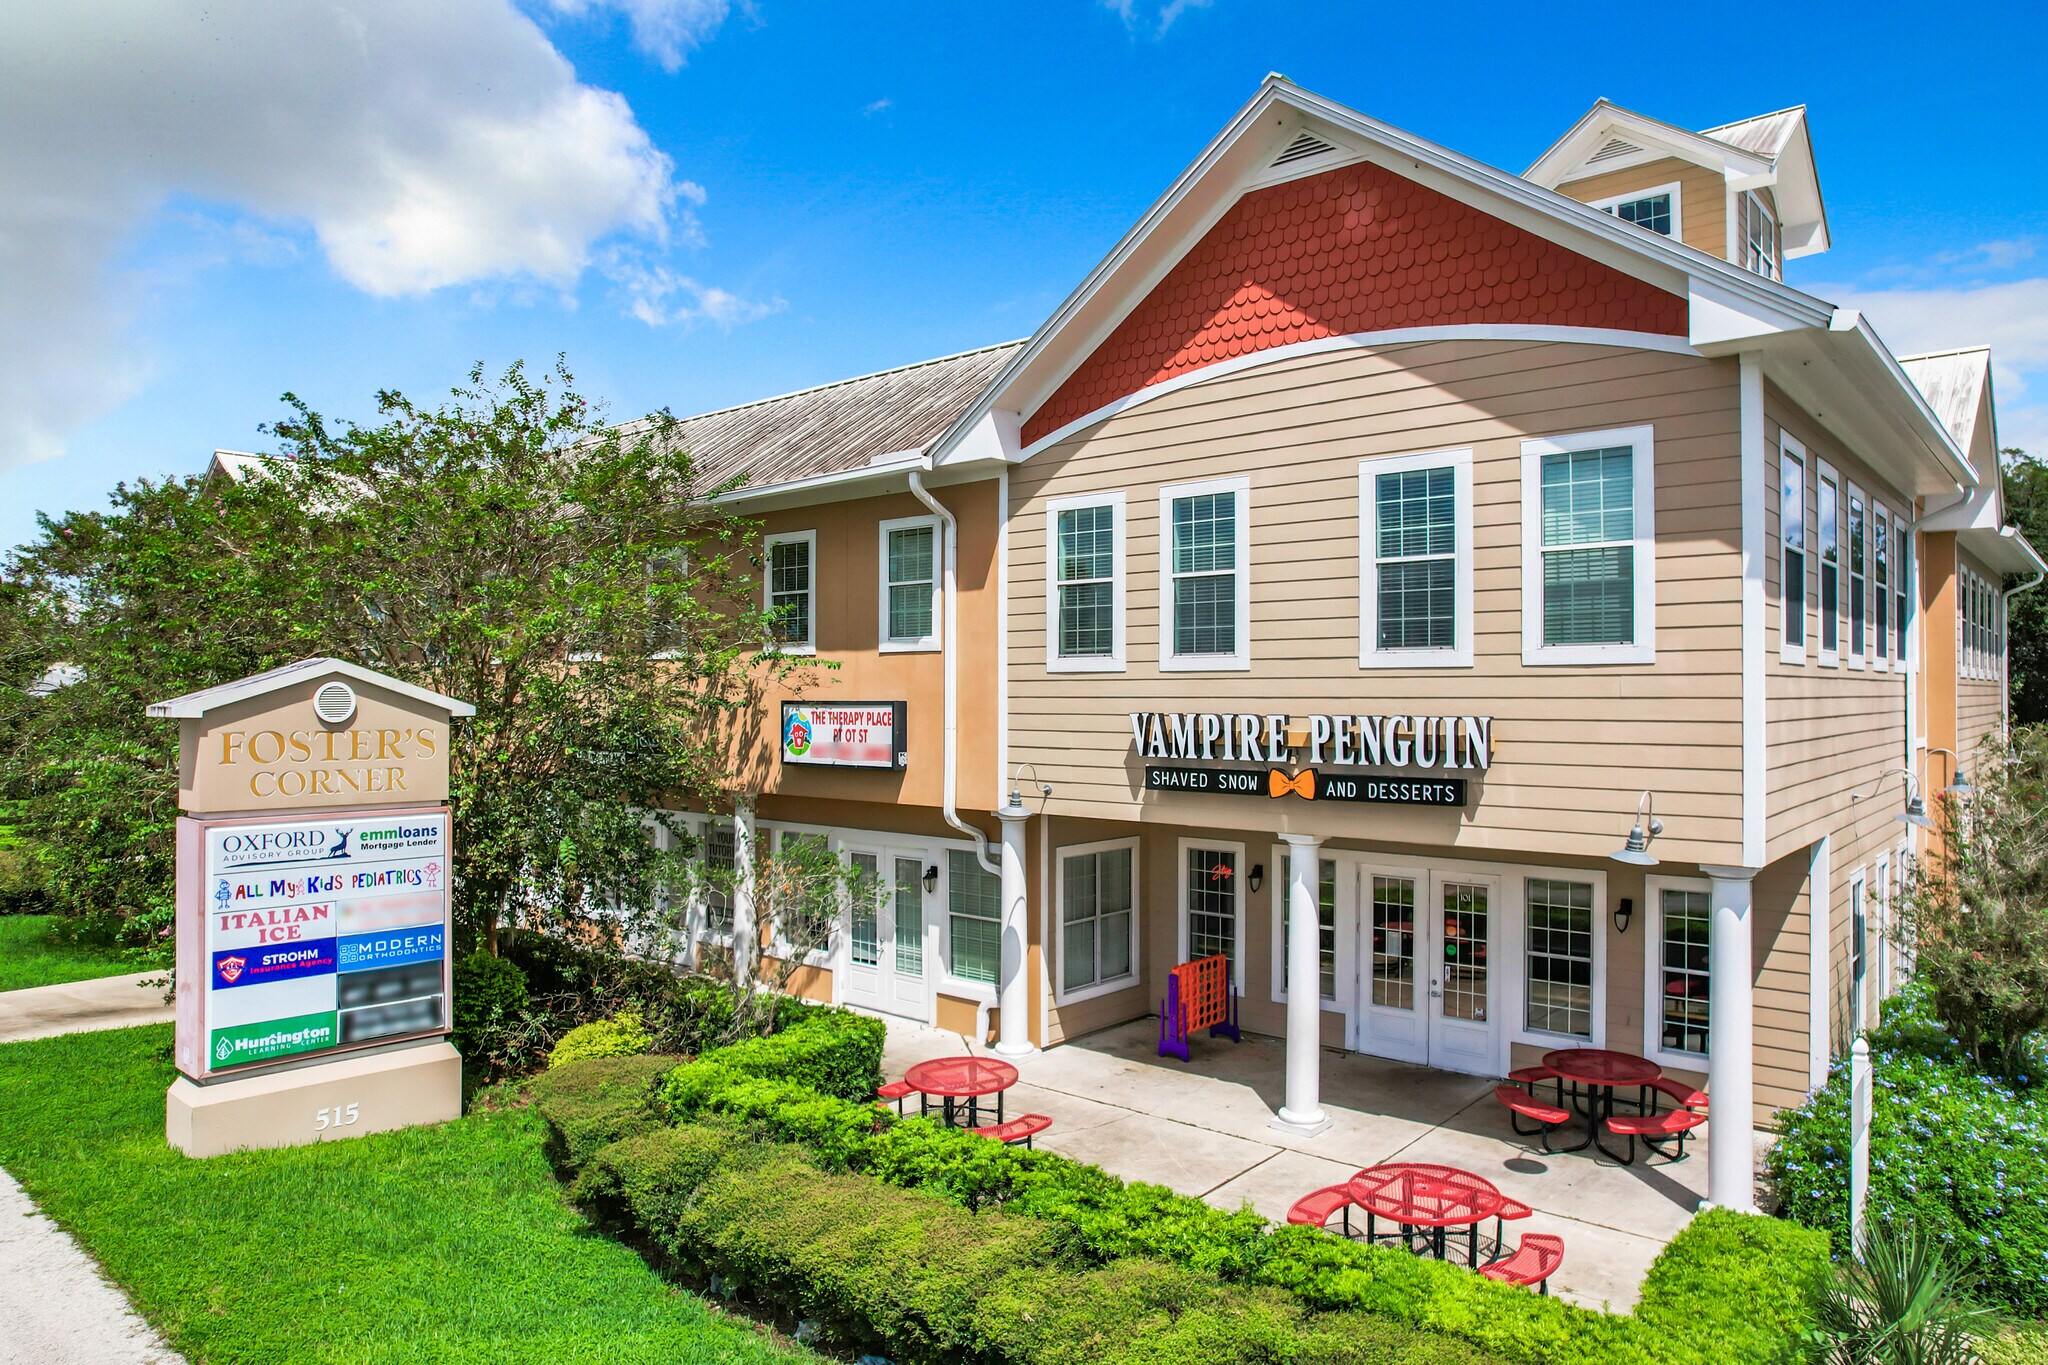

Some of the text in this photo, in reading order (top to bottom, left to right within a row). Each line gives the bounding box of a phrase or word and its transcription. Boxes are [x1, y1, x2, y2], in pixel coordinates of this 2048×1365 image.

[811, 711, 892, 726] THE THERAPY PLACE
[845, 729, 857, 743] OT
[858, 729, 868, 743] ST
[1129, 712, 1492, 769] VAMPIRE PENGUIN
[218, 728, 437, 766] FOSTER'S
[250, 767, 408, 798] CORNER
[1152, 771, 1455, 802] SHAVED SNOW AND DESSERTS
[223, 830, 325, 853] OXFORD
[360, 826, 438, 841] emmloans
[223, 848, 325, 862] ADVISORY GROUP
[361, 839, 437, 851] Mortgage Lender
[235, 884, 264, 900] ALL
[270, 879, 296, 899] My
[352, 869, 422, 889] PEDIATRICS
[220, 904, 329, 931] ITALIAN
[259, 925, 302, 944] ICE
[359, 933, 442, 953] MODERN
[262, 949, 318, 965] STROHM
[359, 944, 442, 961] ORTHODONTICS
[250, 963, 297, 974] Insurance
[299, 957, 333, 968] Agency
[235, 1026, 330, 1051] Huntington
[248, 1036, 330, 1056] LEARNING CENTER
[314, 1102, 360, 1131] 515
